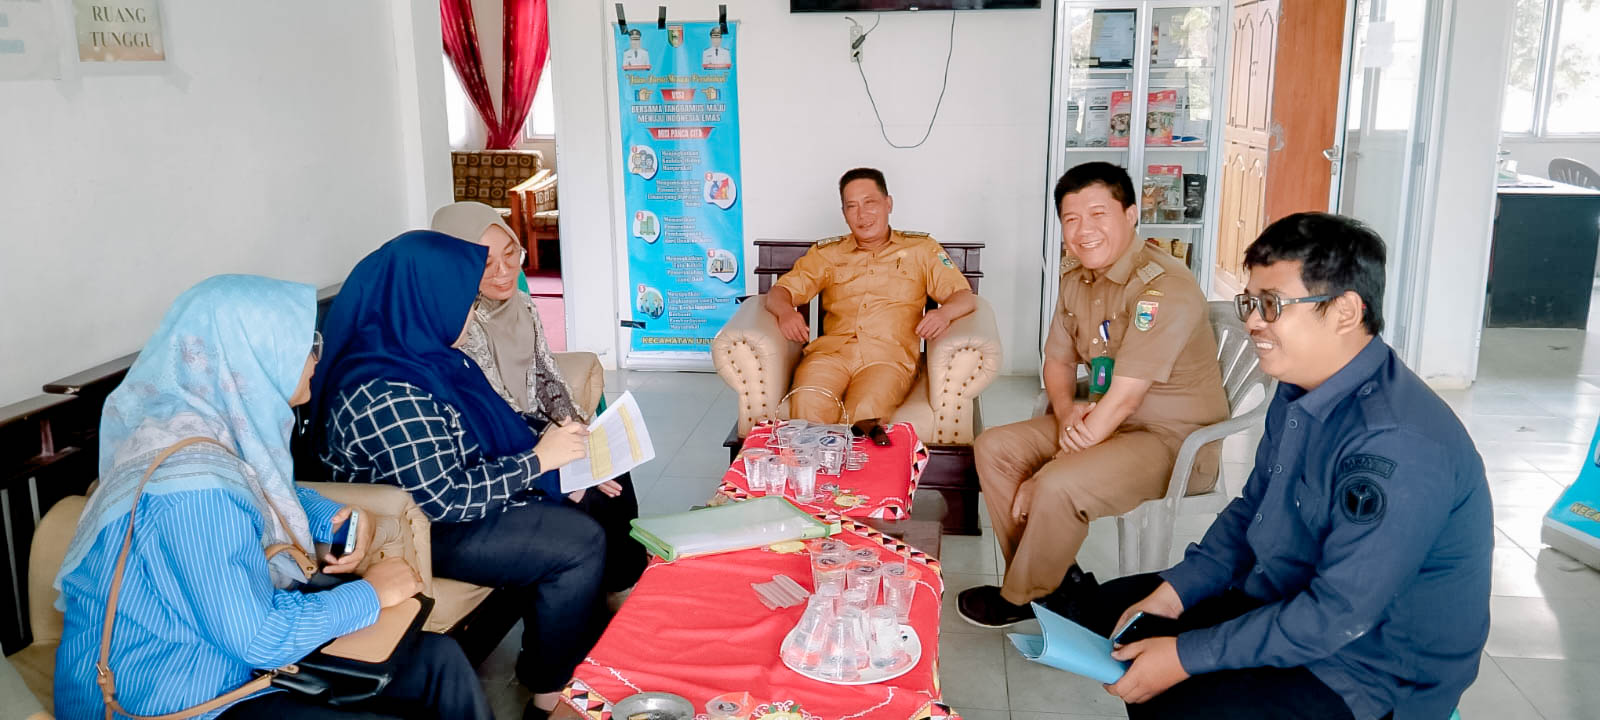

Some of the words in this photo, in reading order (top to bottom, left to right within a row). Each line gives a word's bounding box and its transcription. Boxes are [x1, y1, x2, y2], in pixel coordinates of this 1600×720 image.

[92, 5, 146, 23] RUANG
[89, 31, 152, 48] TUNGGU
[631, 105, 663, 113] BERSAMA
[664, 104, 704, 113] TANGGAMUS
[706, 103, 726, 112] MAJU
[637, 114, 664, 123] MENUJU
[665, 113, 700, 122] INDONESIA
[701, 113, 721, 122] EMAS
[642, 337, 694, 345] KECAMATAN
